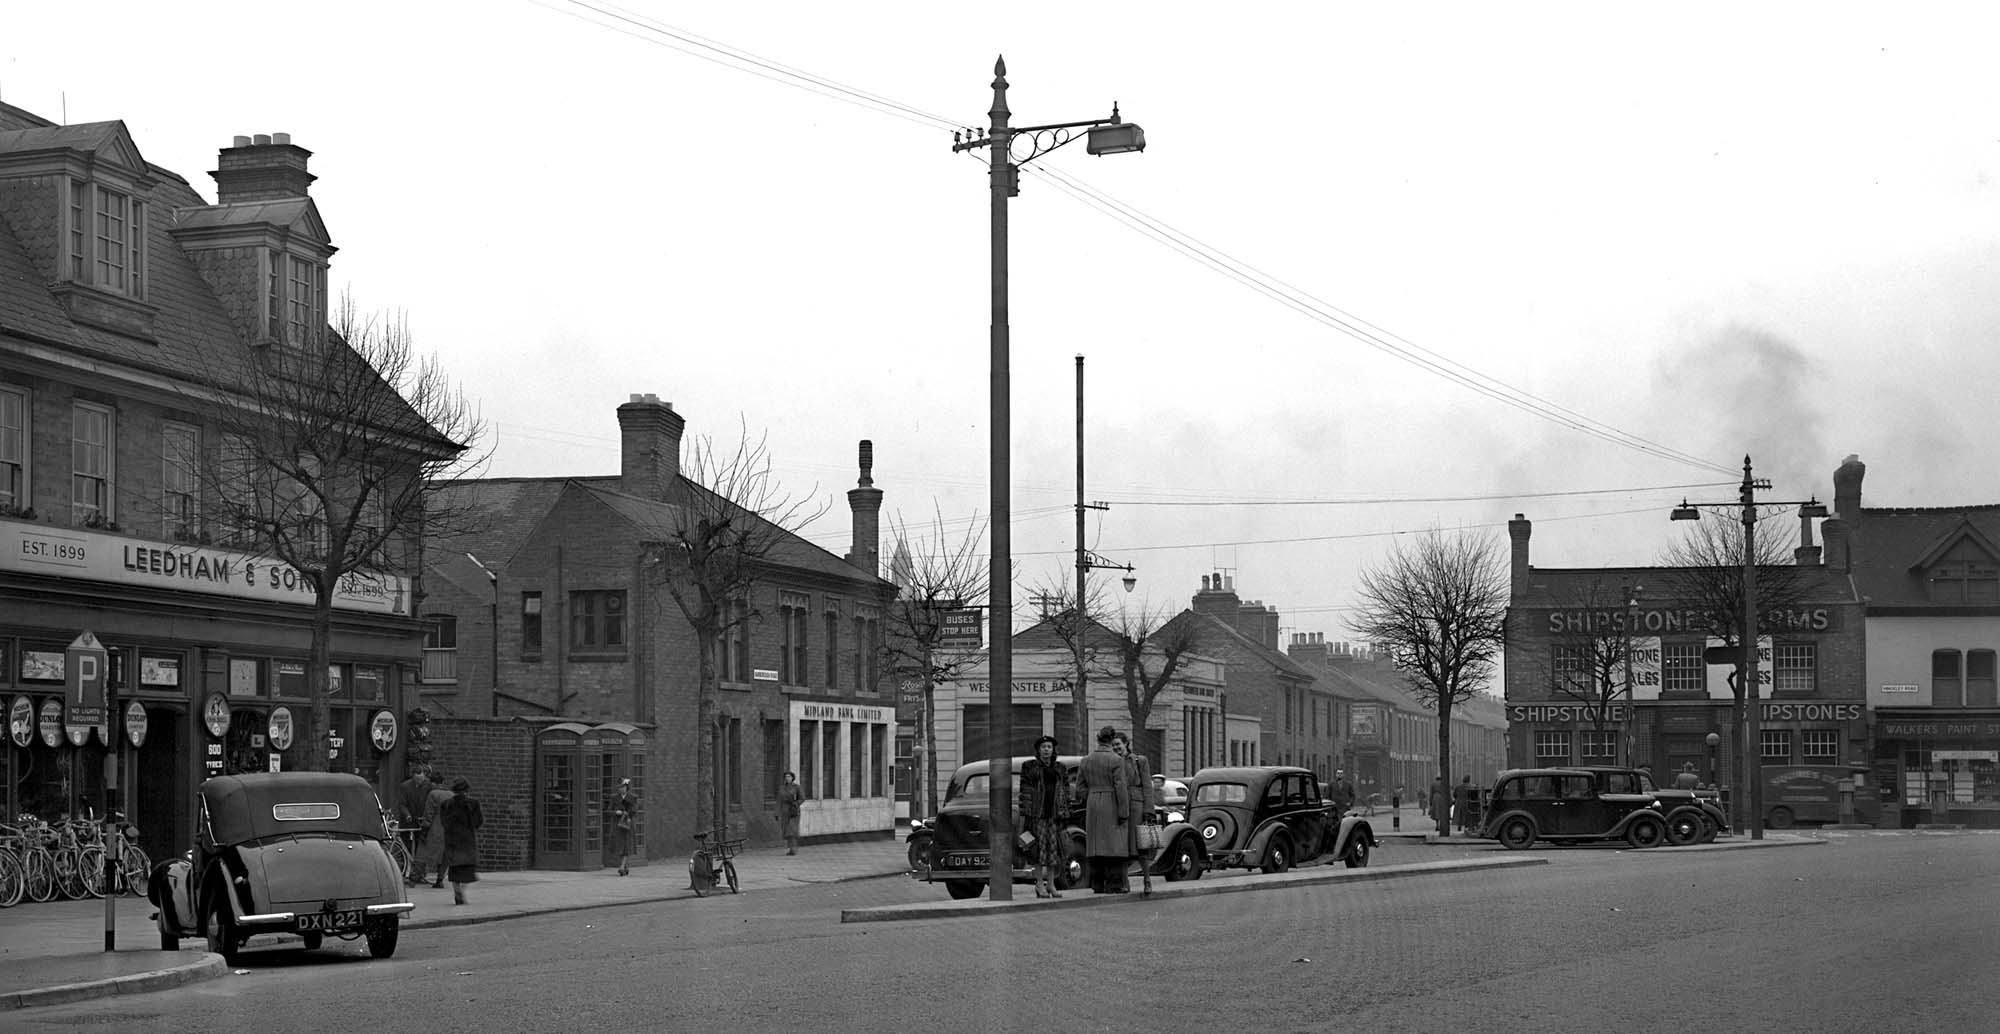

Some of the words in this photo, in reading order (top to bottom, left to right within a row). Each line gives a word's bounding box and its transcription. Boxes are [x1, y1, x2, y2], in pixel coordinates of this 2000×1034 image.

[22, 540, 49, 556] EST.
[54, 544, 86, 561] 1899
[124, 545, 231, 584] LEEDHAM
[245, 562, 256, 586] &
[946, 615, 975, 624] BUSES
[942, 627, 959, 636] STOP
[961, 627, 979, 635] HERE
[78, 655, 97, 703] P
[969, 682, 1047, 693] WESNSTER
[82, 708, 101, 716] LIGHTS
[804, 704, 835, 719] MIDLAND
[838, 707, 854, 720] BANK
[857, 709, 883, 722] LIMITED
[72, 715, 100, 723] REQUIRED
[1947, 724, 1977, 736] PAINT
[208, 744, 222, 755] 600
